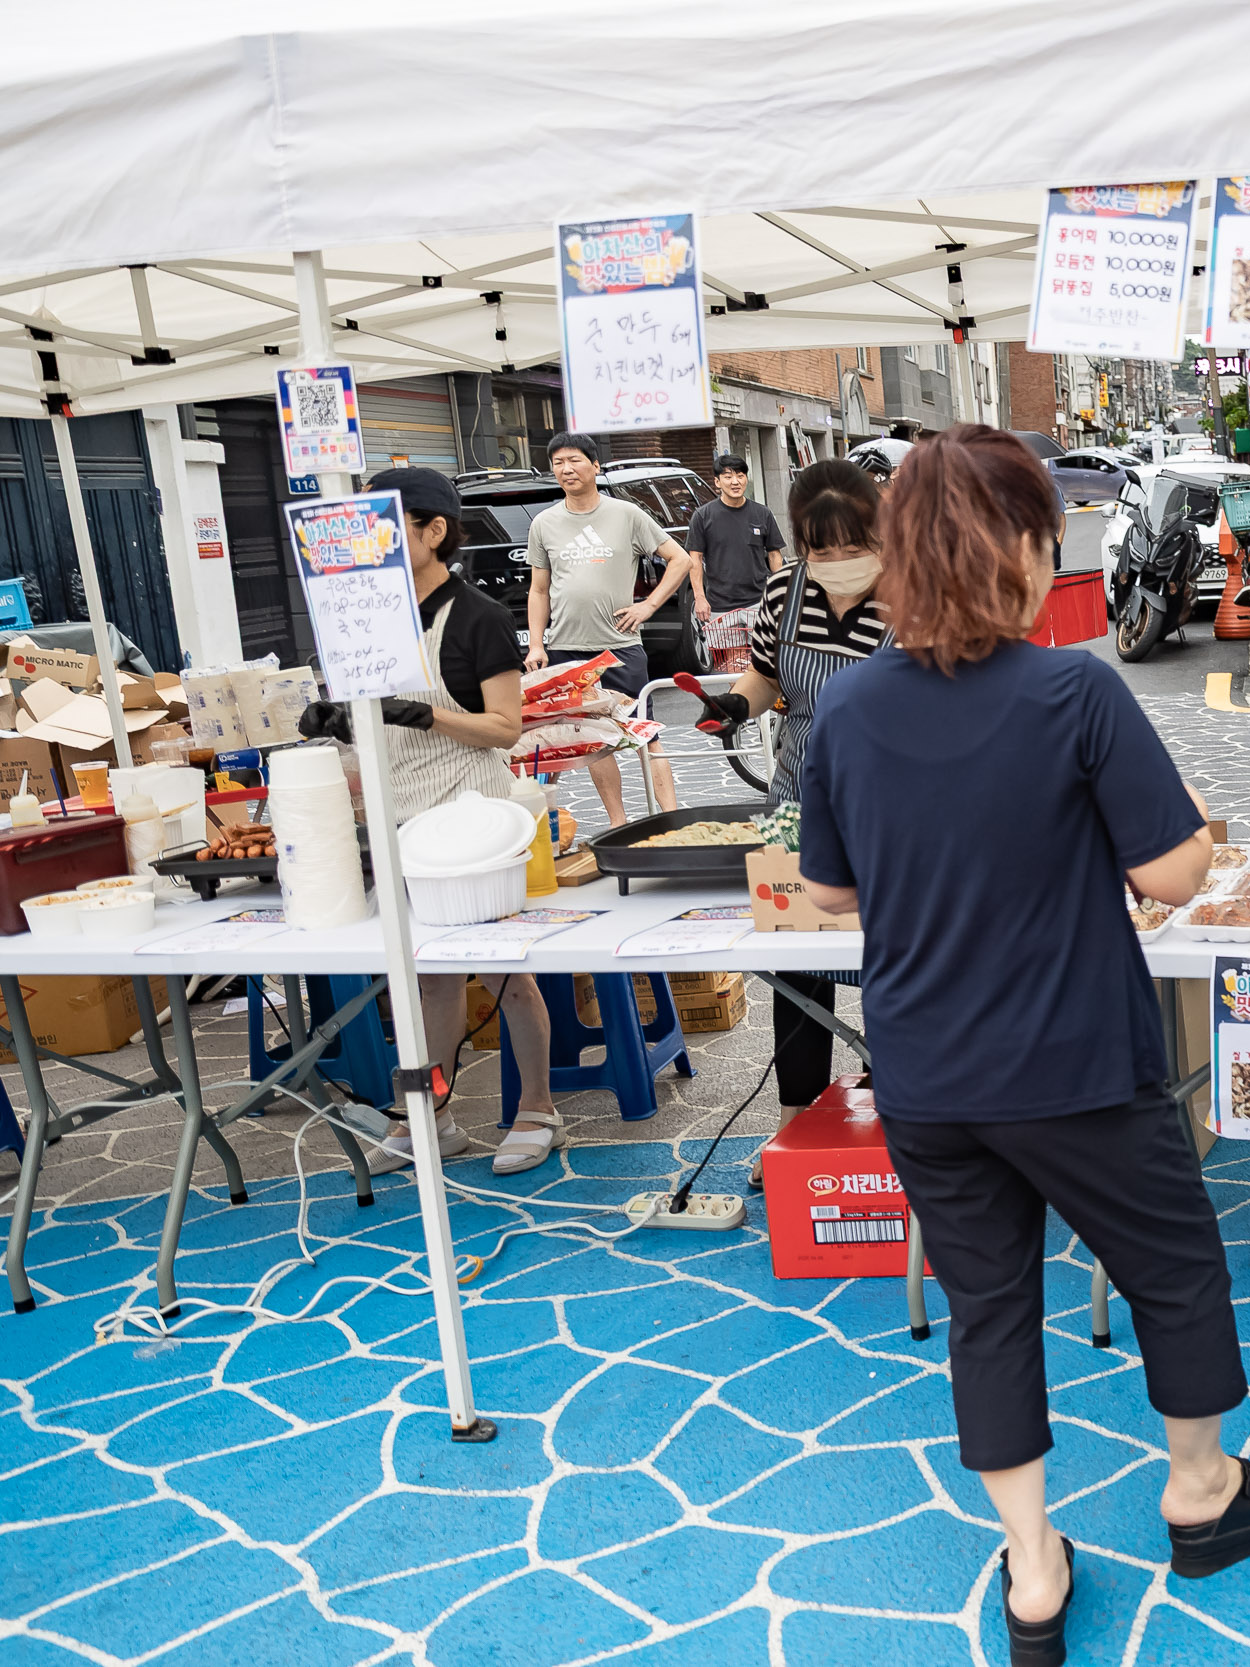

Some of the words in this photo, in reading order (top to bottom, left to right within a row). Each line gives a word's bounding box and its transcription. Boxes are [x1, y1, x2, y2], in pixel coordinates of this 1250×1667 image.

[583, 231, 661, 262] 아차산의
[1058, 228, 1097, 244] 홍어회
[1108, 230, 1179, 251] 10,000원
[1055, 253, 1095, 271] 모듬전
[1106, 256, 1176, 277] 10,000원
[1053, 278, 1092, 296] 닭똥집
[1109, 283, 1172, 303] 5,000원
[295, 479, 317, 491] 114
[306, 514, 370, 543] 아차산의
[559, 545, 614, 560] adidas
[1204, 569, 1227, 579] 9769
[25, 655, 55, 666] MICRO
[56, 660, 84, 670] MATIC
[813, 1179, 833, 1190] 하림
